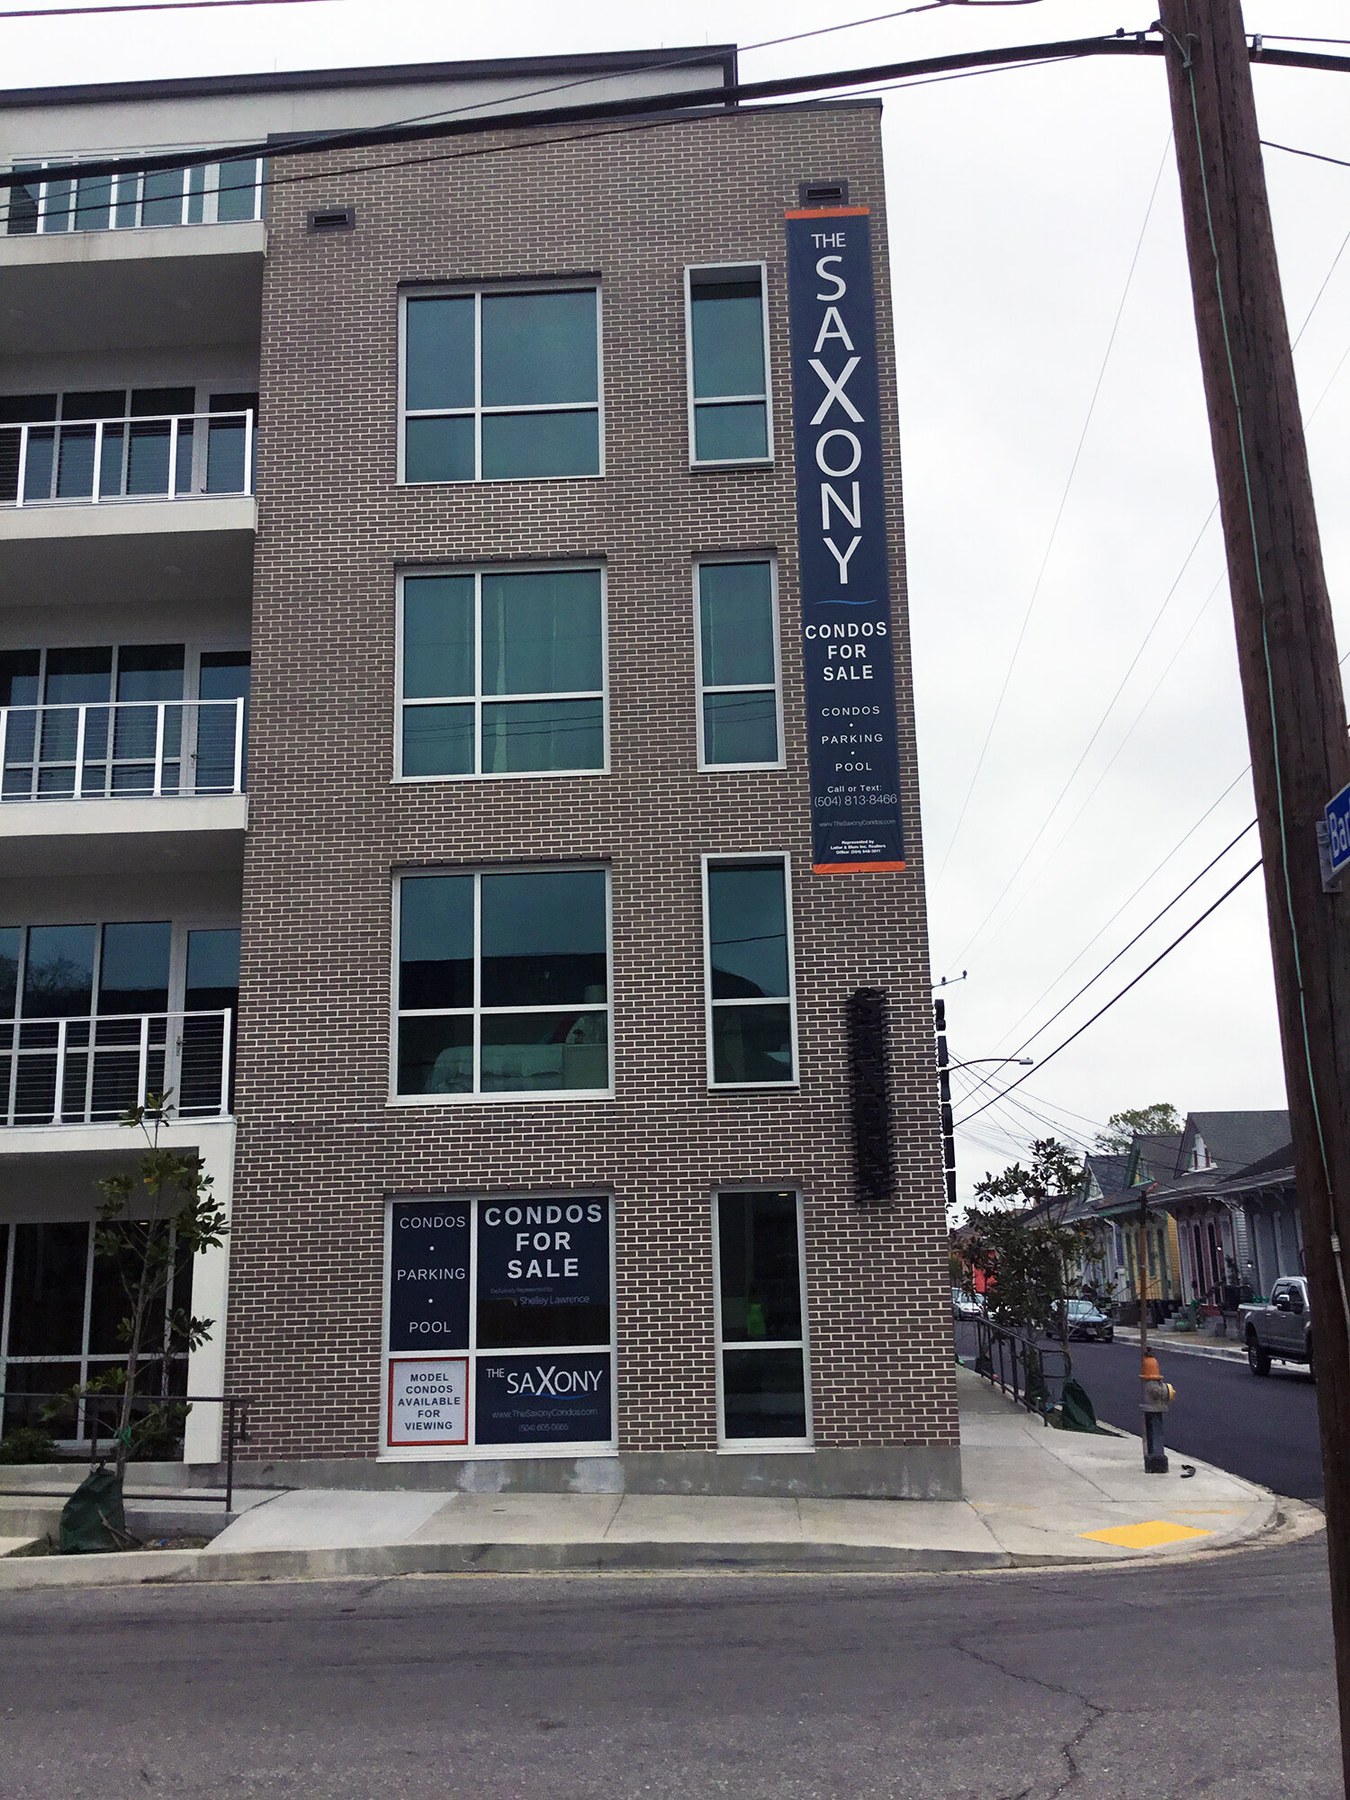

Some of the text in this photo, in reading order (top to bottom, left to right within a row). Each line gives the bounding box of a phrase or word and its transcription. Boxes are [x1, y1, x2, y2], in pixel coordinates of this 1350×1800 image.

[811, 232, 847, 249] THE
[808, 254, 866, 585] SAXONY
[805, 621, 888, 640] CONDOS
[827, 643, 867, 660] FOR
[822, 665, 874, 682] SALE
[821, 705, 881, 717] CONDOS
[821, 733, 884, 745] PARKING
[835, 762, 872, 772] POOL
[827, 785, 845, 793] Call
[860, 784, 882, 792] Text:
[814, 793, 897, 807] (504) 813-8466
[484, 1203, 603, 1227] CONDOS
[399, 1216, 466, 1229] CONDOS
[515, 1231, 571, 1252] FOR
[397, 1267, 466, 1281] PARKING
[507, 1257, 579, 1279] SALE
[519, 1295, 590, 1306] Shelley Lawrence
[409, 1321, 452, 1334] POOL
[410, 1373, 449, 1382] MODEL
[486, 1367, 505, 1378] THE
[506, 1365, 603, 1396] SAXONY
[405, 1385, 453, 1394] CONDOS
[397, 1396, 461, 1406] AVAILABLE
[417, 1409, 441, 1418] FOR
[404, 1421, 453, 1431] VIEWING
